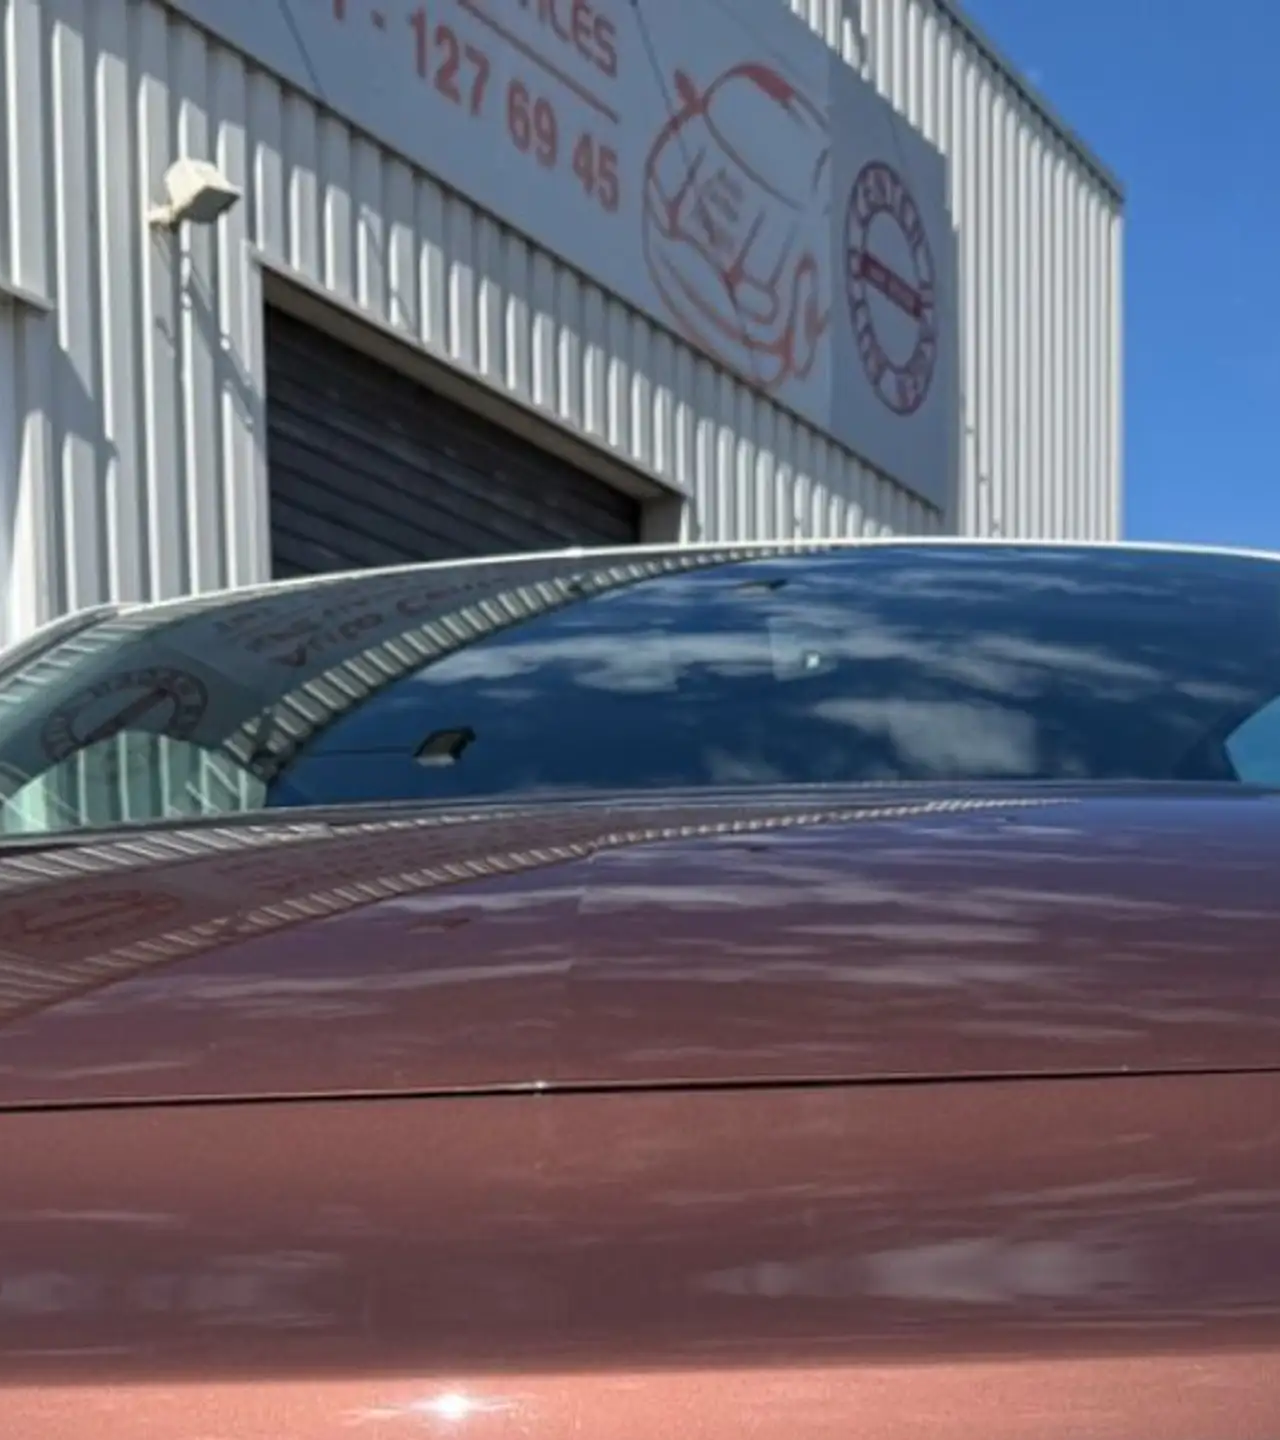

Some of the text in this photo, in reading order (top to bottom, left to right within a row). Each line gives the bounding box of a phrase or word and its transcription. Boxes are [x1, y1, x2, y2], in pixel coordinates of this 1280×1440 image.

[408, 6, 491, 118] 127
[506, 77, 558, 171] 69
[572, 131, 619, 214] 45
